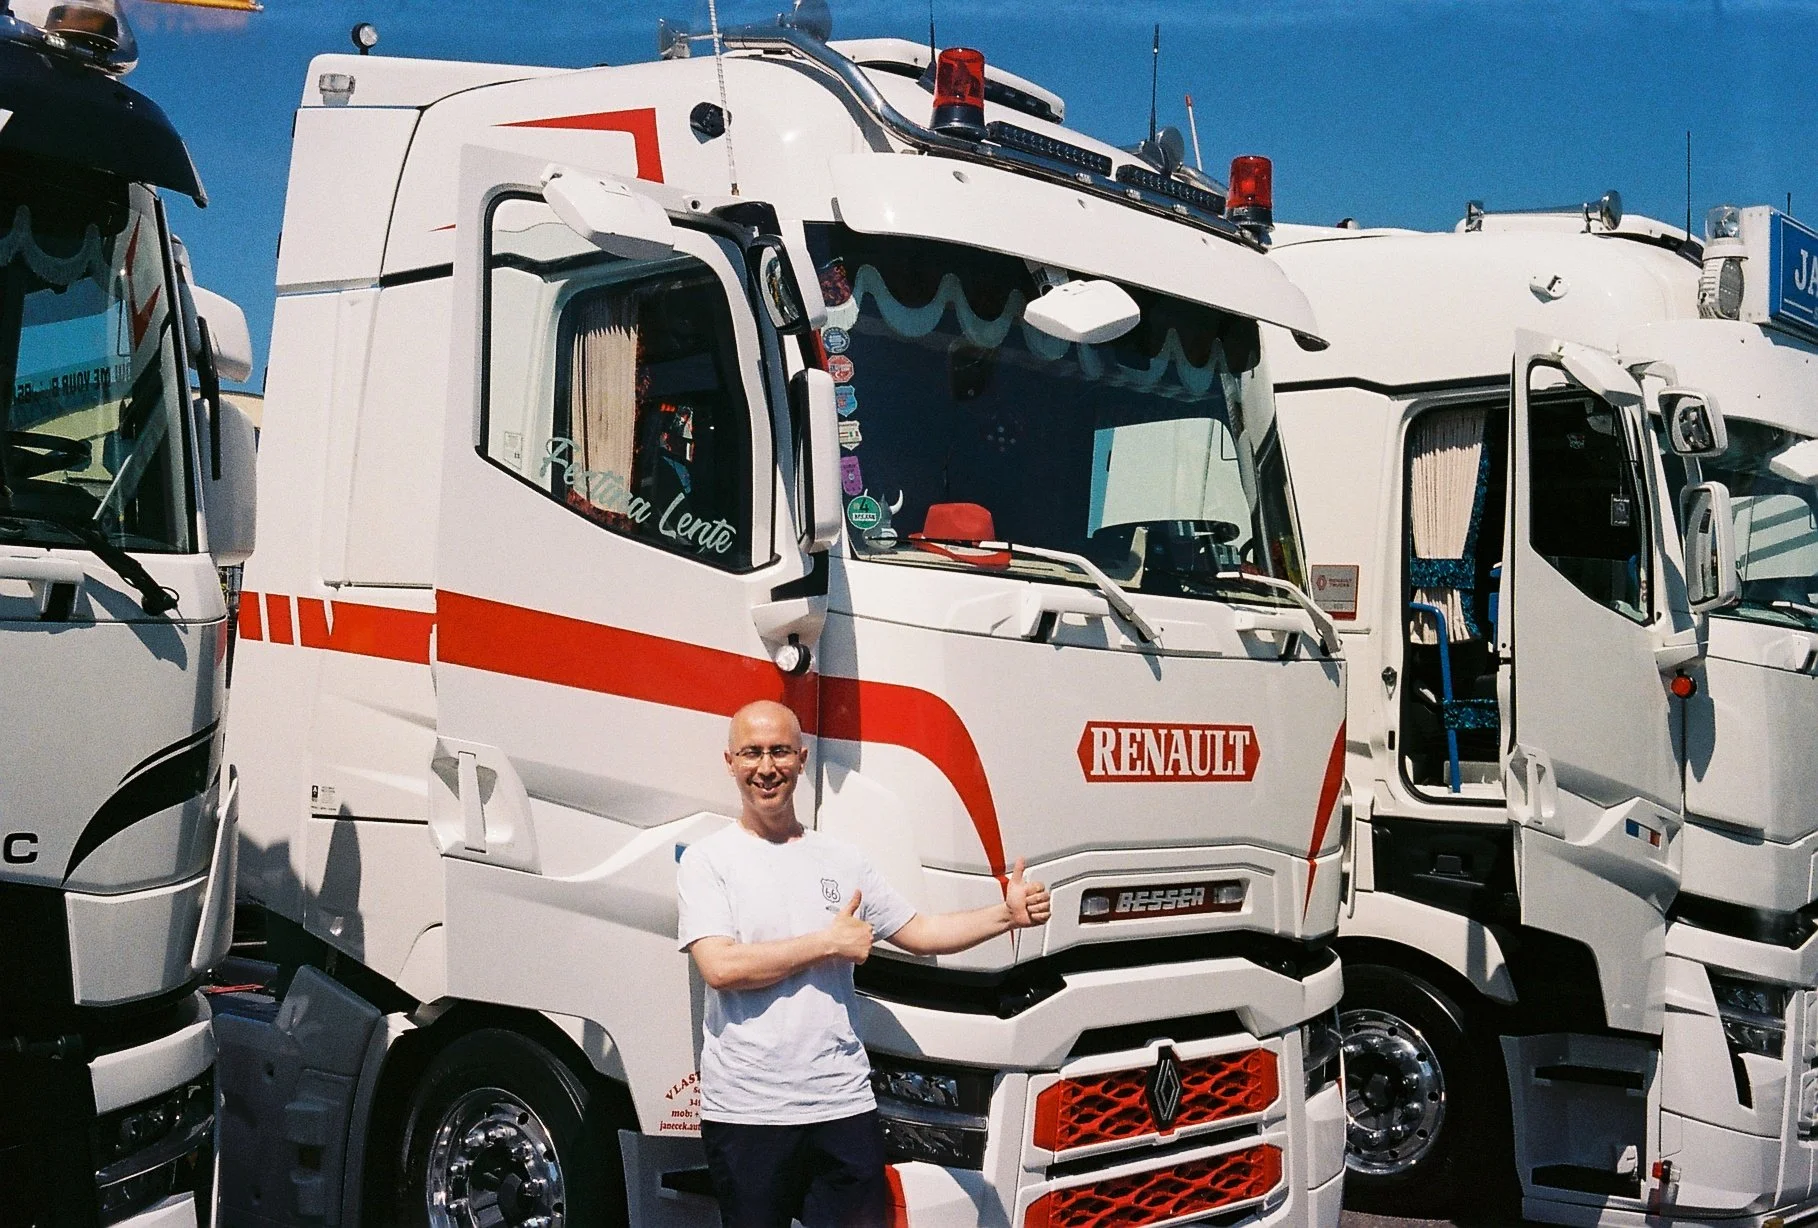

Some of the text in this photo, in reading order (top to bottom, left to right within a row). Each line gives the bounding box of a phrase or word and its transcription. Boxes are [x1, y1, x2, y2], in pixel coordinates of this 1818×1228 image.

[859, 498, 869, 513] 4
[658, 492, 737, 554] Lente
[1090, 727, 1250, 776] RENAULT
[3, 832, 39, 864] C
[825, 887, 838, 900] 66
[1115, 887, 1206, 913] BESSER
[671, 1109, 692, 1118] mob:
